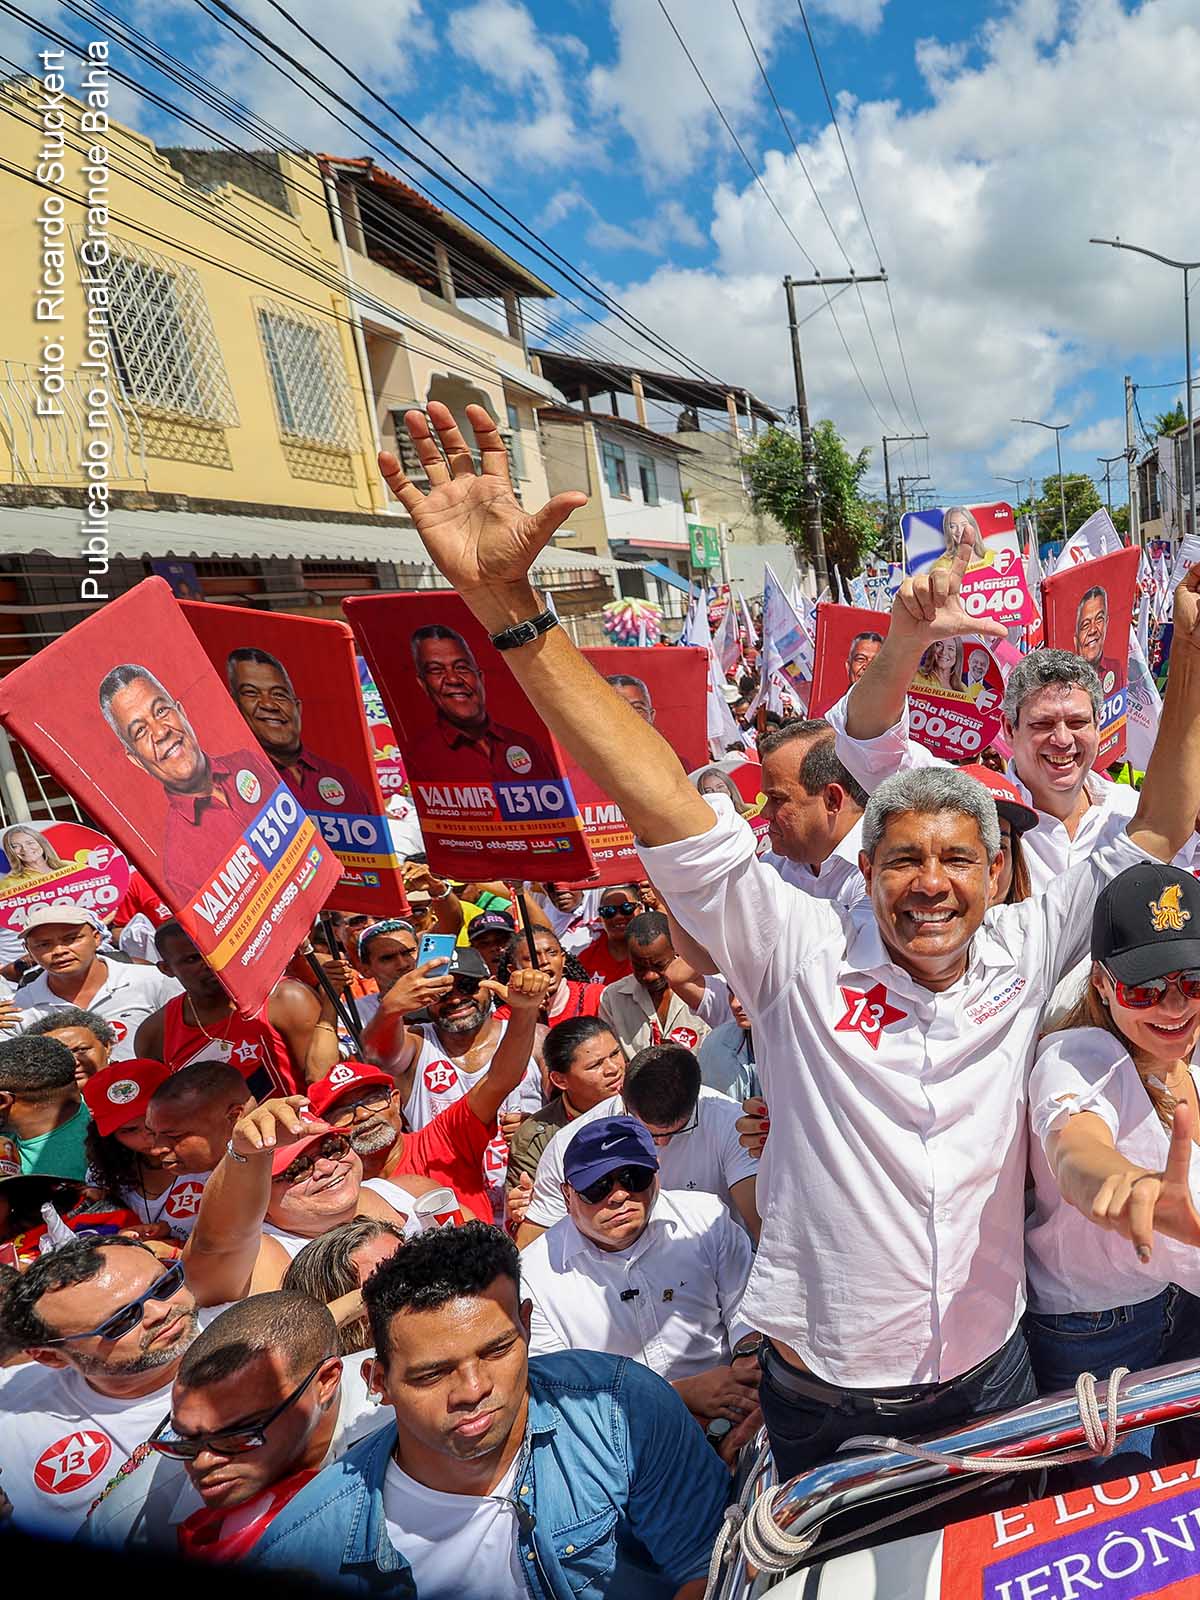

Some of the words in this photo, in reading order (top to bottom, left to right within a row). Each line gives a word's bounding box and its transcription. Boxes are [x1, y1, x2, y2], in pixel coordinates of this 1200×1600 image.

[973, 577, 1020, 592] Mansur
[960, 587, 1024, 616] 040
[932, 688, 946, 697] PELA
[908, 695, 938, 715] bíola
[938, 707, 984, 730] Mansur
[908, 709, 982, 751] 0040
[417, 785, 497, 809] VALMIR
[499, 784, 565, 814] 1310
[486, 839, 528, 852] otto555
[530, 839, 555, 849] LULA
[556, 839, 571, 850] 13
[192, 844, 259, 925] VALMIR
[249, 791, 298, 858] 1310
[296, 861, 312, 884] LULA
[364, 874, 379, 885] 13
[56, 874, 113, 897] Mansur
[848, 997, 885, 1033] 13
[240, 1046, 253, 1058] 13
[333, 1068, 350, 1080] 13
[434, 1072, 448, 1083] 13
[178, 1192, 194, 1208] 13
[57, 1450, 85, 1474] 13
